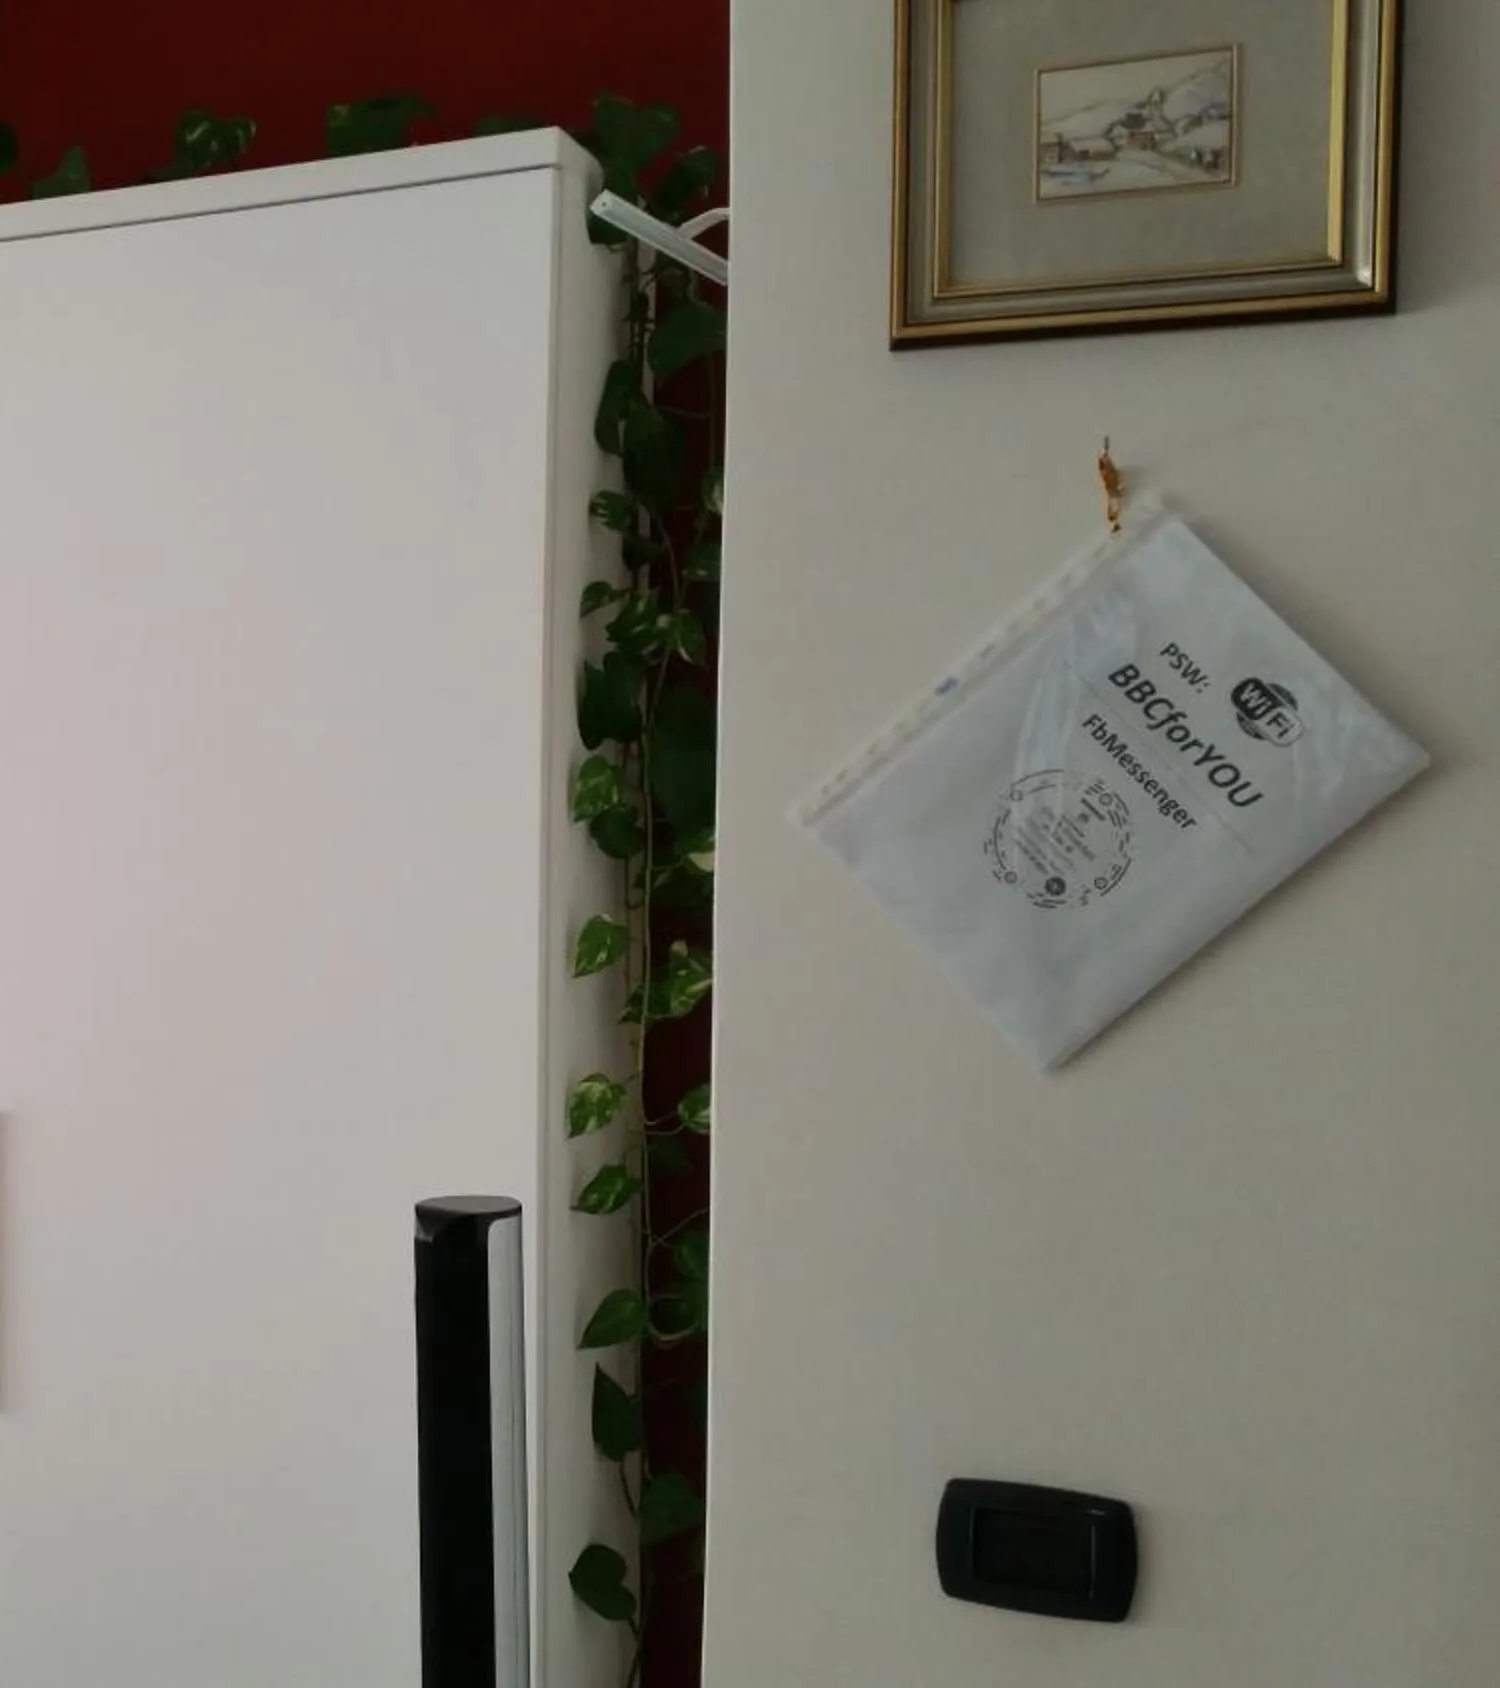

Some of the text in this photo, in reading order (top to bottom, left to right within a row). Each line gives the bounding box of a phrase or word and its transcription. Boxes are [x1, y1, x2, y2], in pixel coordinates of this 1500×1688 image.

[1160, 642, 1211, 693] PSW:
[1081, 713, 1198, 829] FbMessenger
[1108, 663, 1265, 808] BBCforYOU
